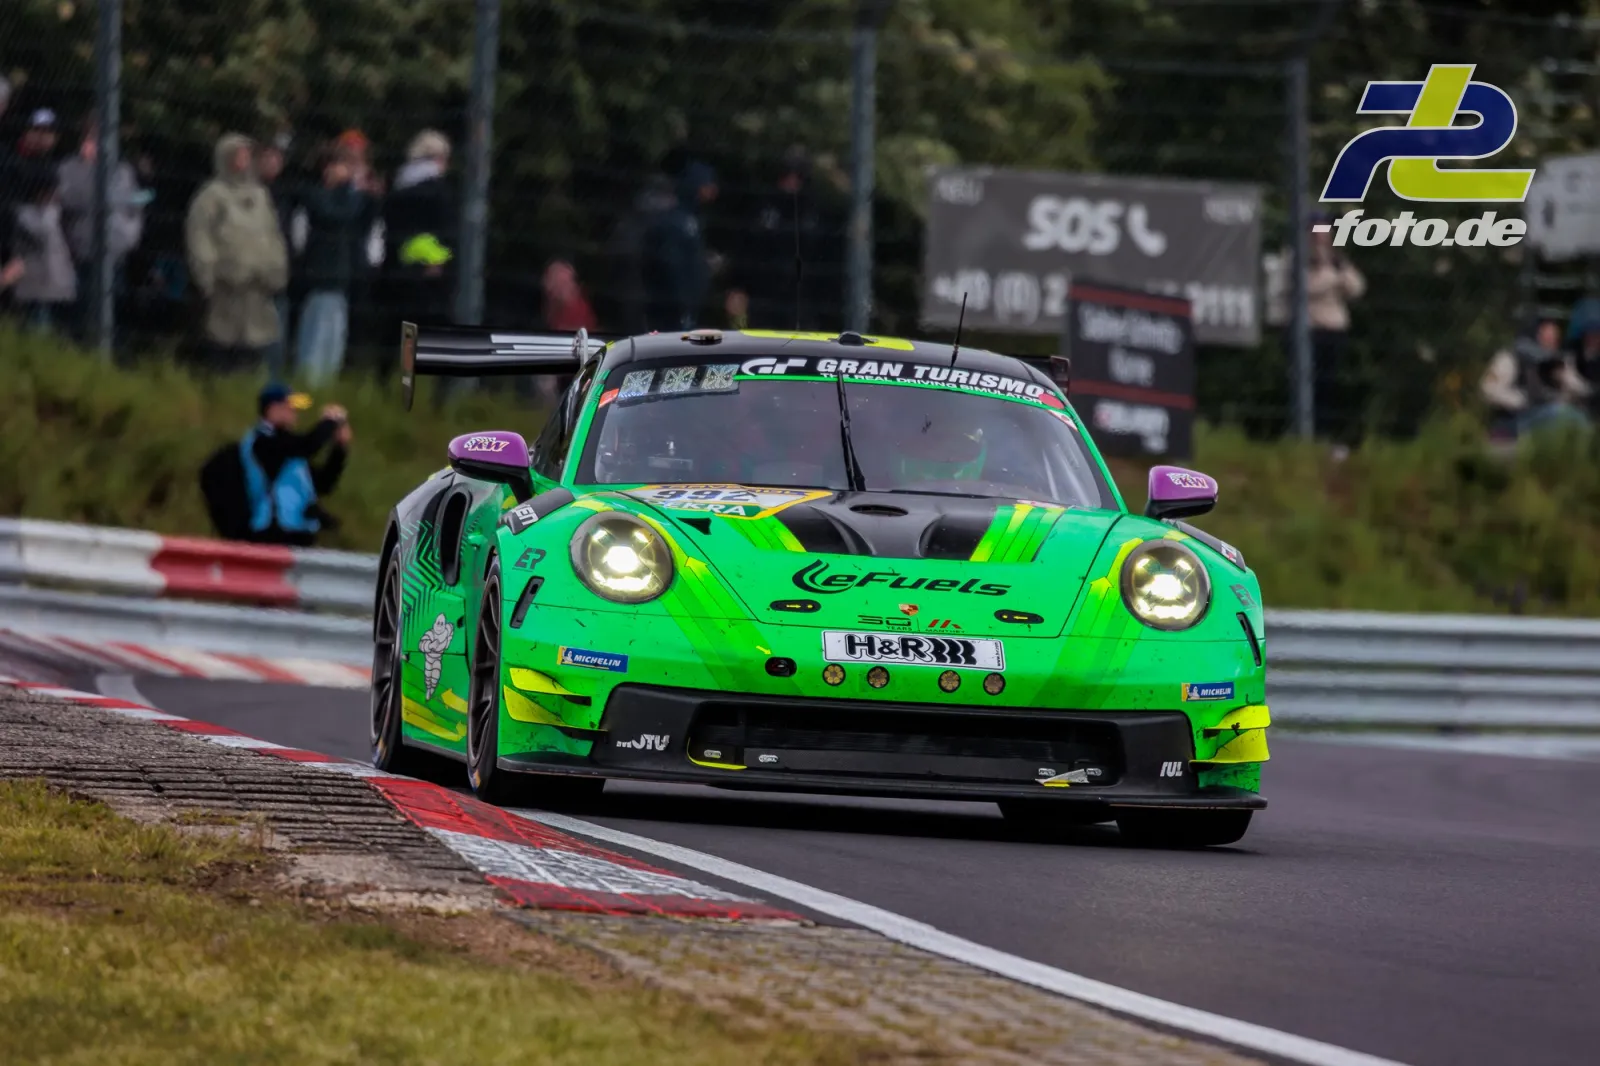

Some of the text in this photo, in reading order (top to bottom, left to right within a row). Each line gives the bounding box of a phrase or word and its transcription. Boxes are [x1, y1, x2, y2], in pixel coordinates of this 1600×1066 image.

[1022, 196, 1124, 255] SOS
[816, 358, 1042, 398] GRAN TURISMO
[854, 374, 893, 384] REAL
[896, 377, 958, 389] DRIVING
[959, 384, 1043, 405] SIMULATOR
[821, 571, 1012, 597] eFuels
[573, 653, 622, 668] MICHELIN
[845, 634, 933, 662] H&R
[1200, 687, 1232, 697] MICHELIN
